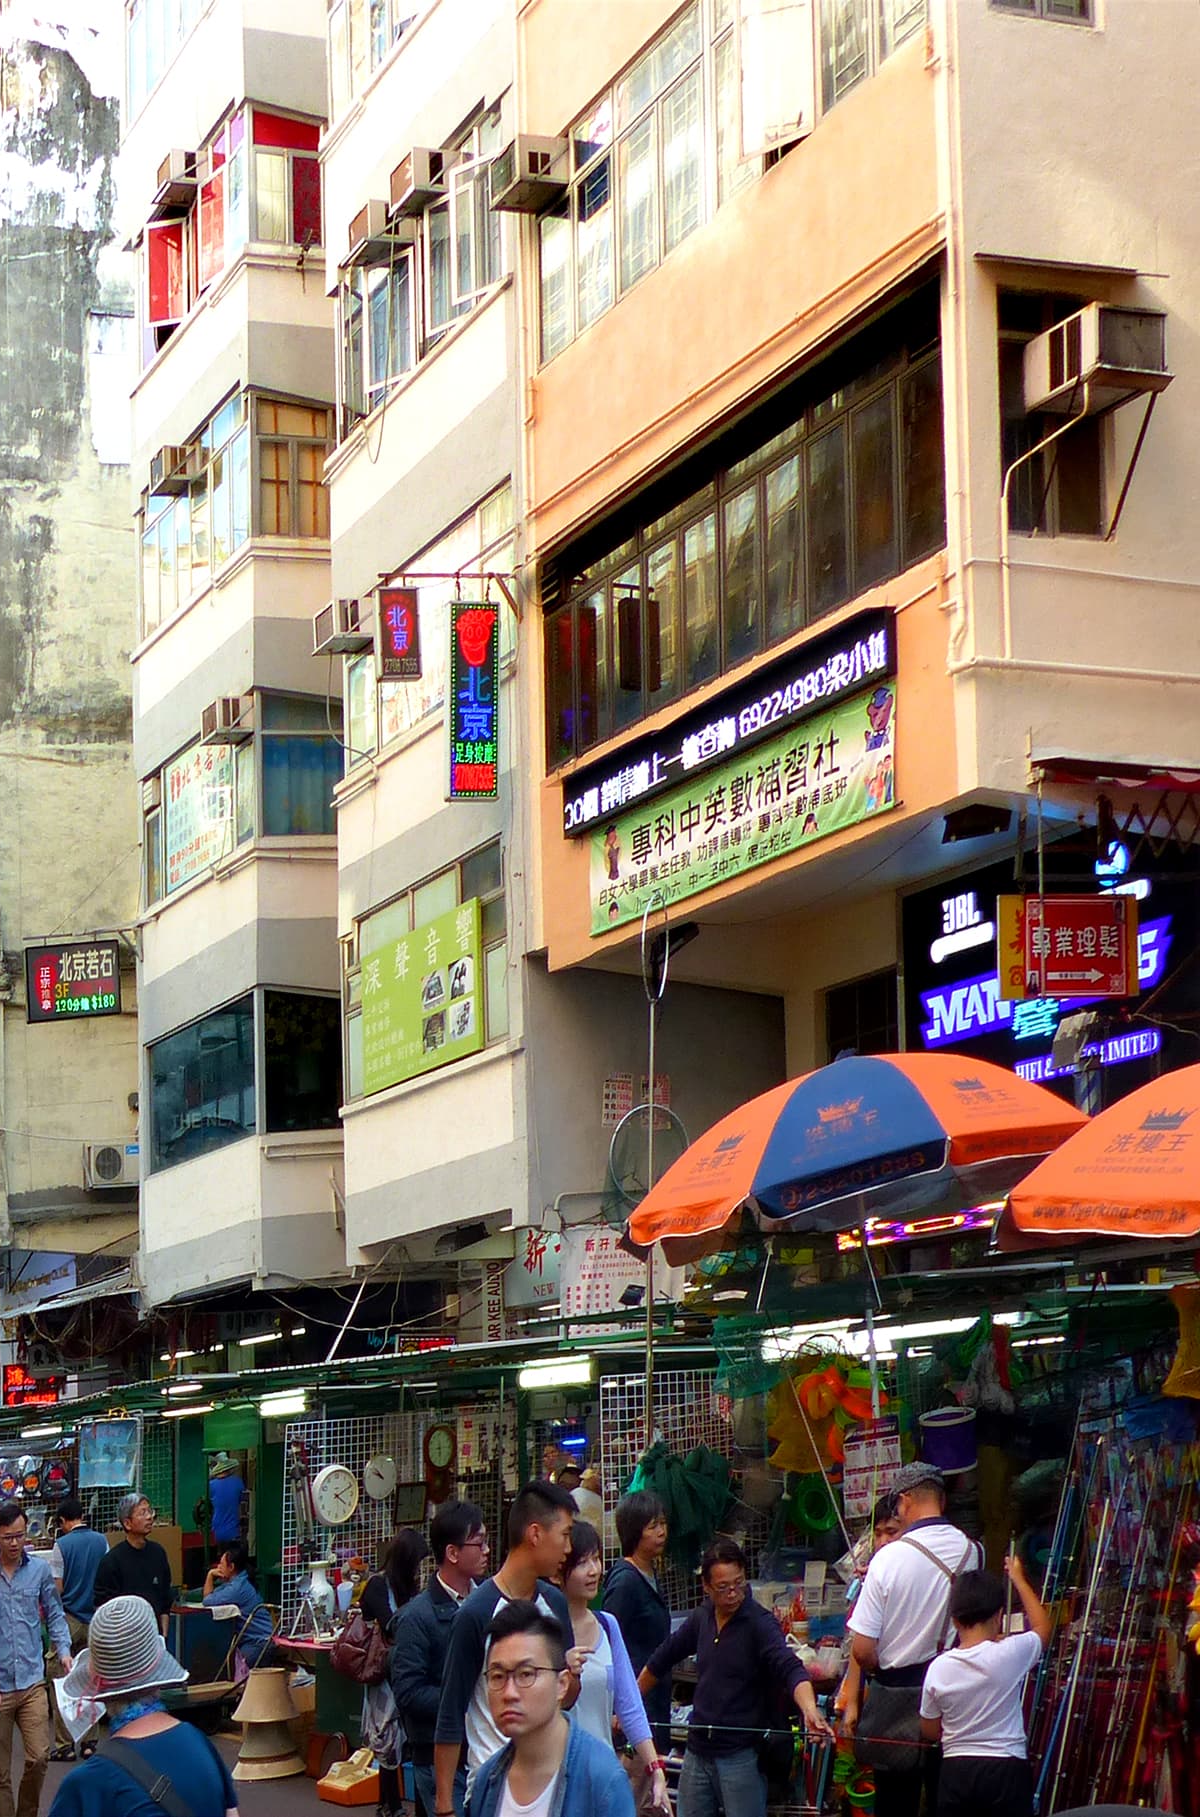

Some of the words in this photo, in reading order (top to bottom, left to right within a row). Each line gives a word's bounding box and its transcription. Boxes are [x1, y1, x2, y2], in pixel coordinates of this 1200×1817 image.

[386, 606, 409, 650] 北京
[458, 667, 492, 740] 北京
[631, 729, 840, 866] 專科中英數補習社
[942, 892, 981, 933] JBL
[1031, 925, 1120, 959] 專業理髮
[59, 949, 113, 982] 北京若石
[533, 1282, 554, 1297] NEW
[488, 1299, 500, 1318] KEE
[488, 1323, 501, 1342] AR
